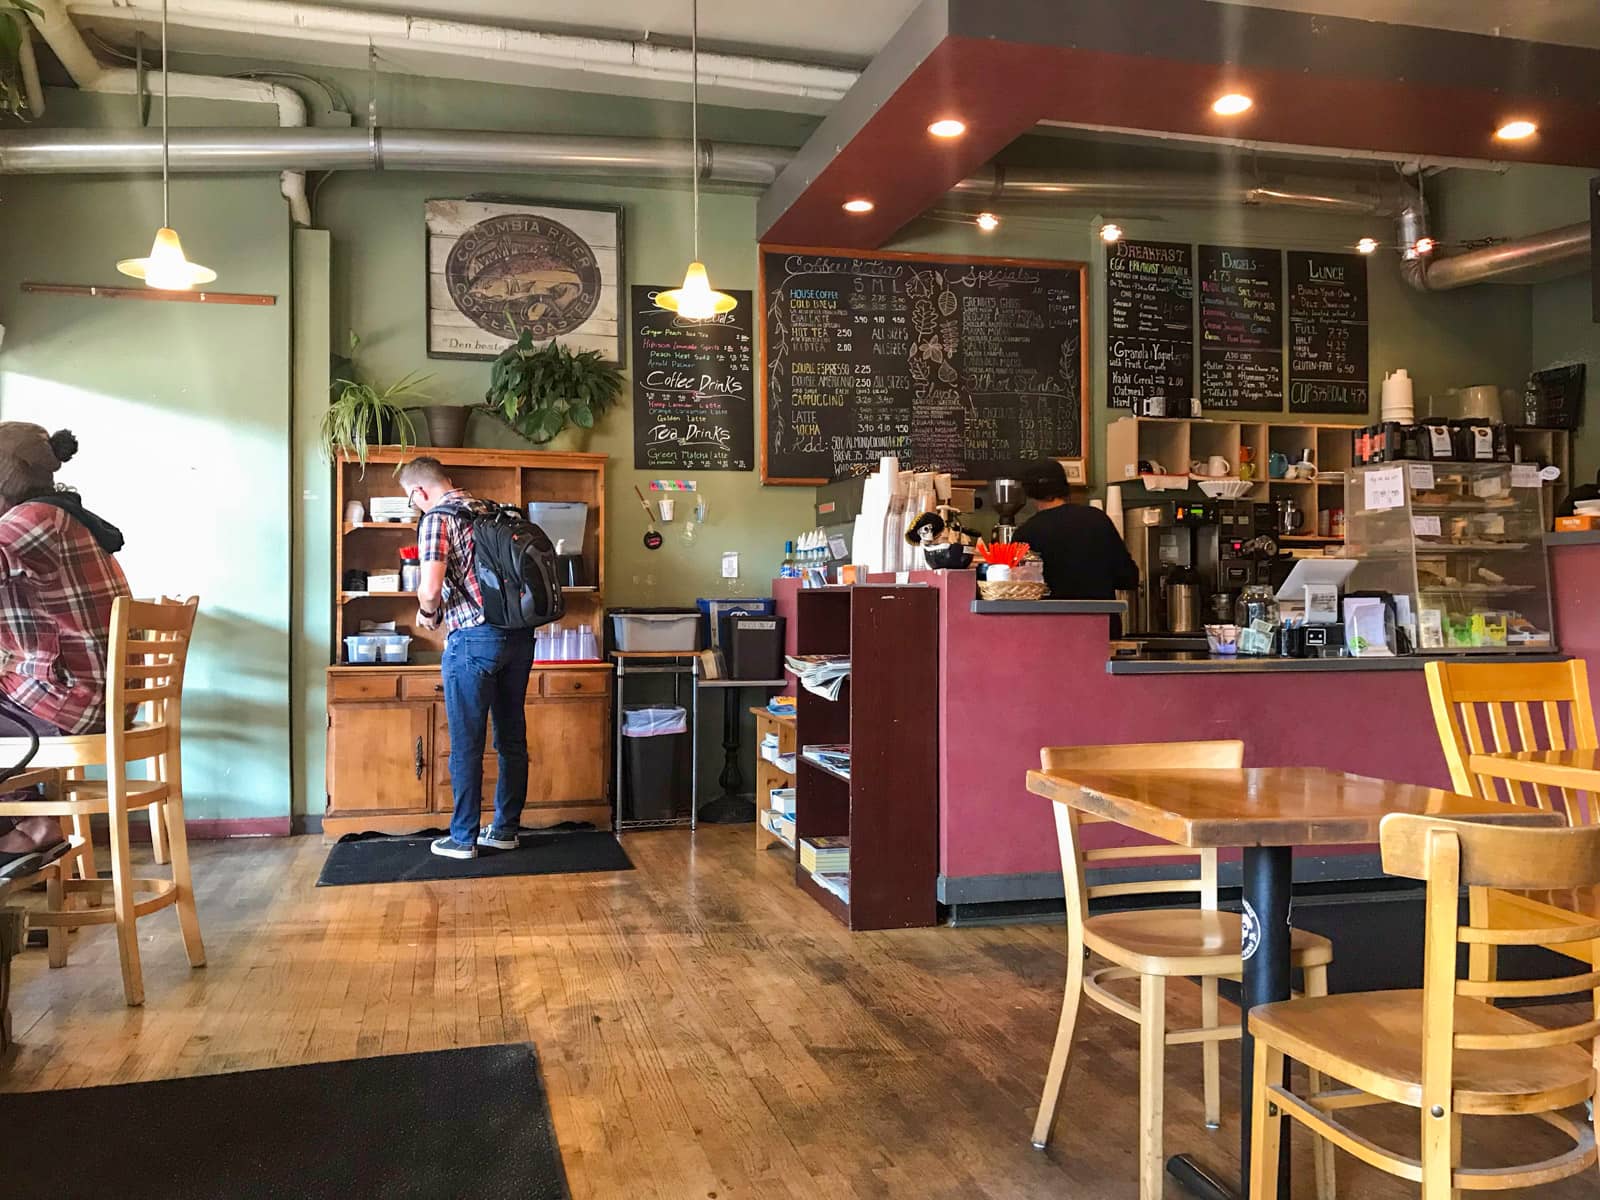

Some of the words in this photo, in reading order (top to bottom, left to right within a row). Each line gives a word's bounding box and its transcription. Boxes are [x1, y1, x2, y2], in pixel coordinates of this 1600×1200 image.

[457, 220, 541, 262] COLUMBIA
[548, 227, 591, 268] RIVER
[1116, 240, 1185, 263] BREAKFAST
[784, 255, 847, 275] Coffee
[1109, 257, 1126, 271] EGG
[1222, 251, 1257, 271] BAGELS
[961, 265, 1041, 289] Specials
[1308, 259, 1345, 281] LUNCH
[853, 277, 865, 294] S
[871, 278, 885, 294] M
[891, 279, 904, 295] L
[789, 288, 815, 300] HOUSE
[815, 289, 839, 300] COFFEE
[456, 282, 514, 336] COFFEE
[790, 299, 811, 310] COLD
[791, 327, 808, 338] HOT
[811, 328, 829, 339] TEA
[1295, 322, 1318, 335] FULL
[1295, 336, 1312, 345] HALF
[1113, 340, 1149, 359] Granola
[791, 362, 816, 375] DOUBLE
[817, 363, 850, 376] ESPRESSO
[1292, 359, 1333, 372] GLUTEN-FREE
[646, 370, 696, 389] Coffee
[791, 375, 816, 388] DOUBLE
[887, 375, 910, 390] SIZES
[1114, 385, 1145, 397] Oatmeal
[1290, 382, 1313, 404] CUP
[791, 393, 845, 407] CAPPUCCINO
[1112, 396, 1131, 408] Hard
[791, 410, 817, 425] LATTE
[964, 418, 998, 430] STEAMER
[648, 424, 678, 441] Tea
[647, 447, 678, 461] Green
